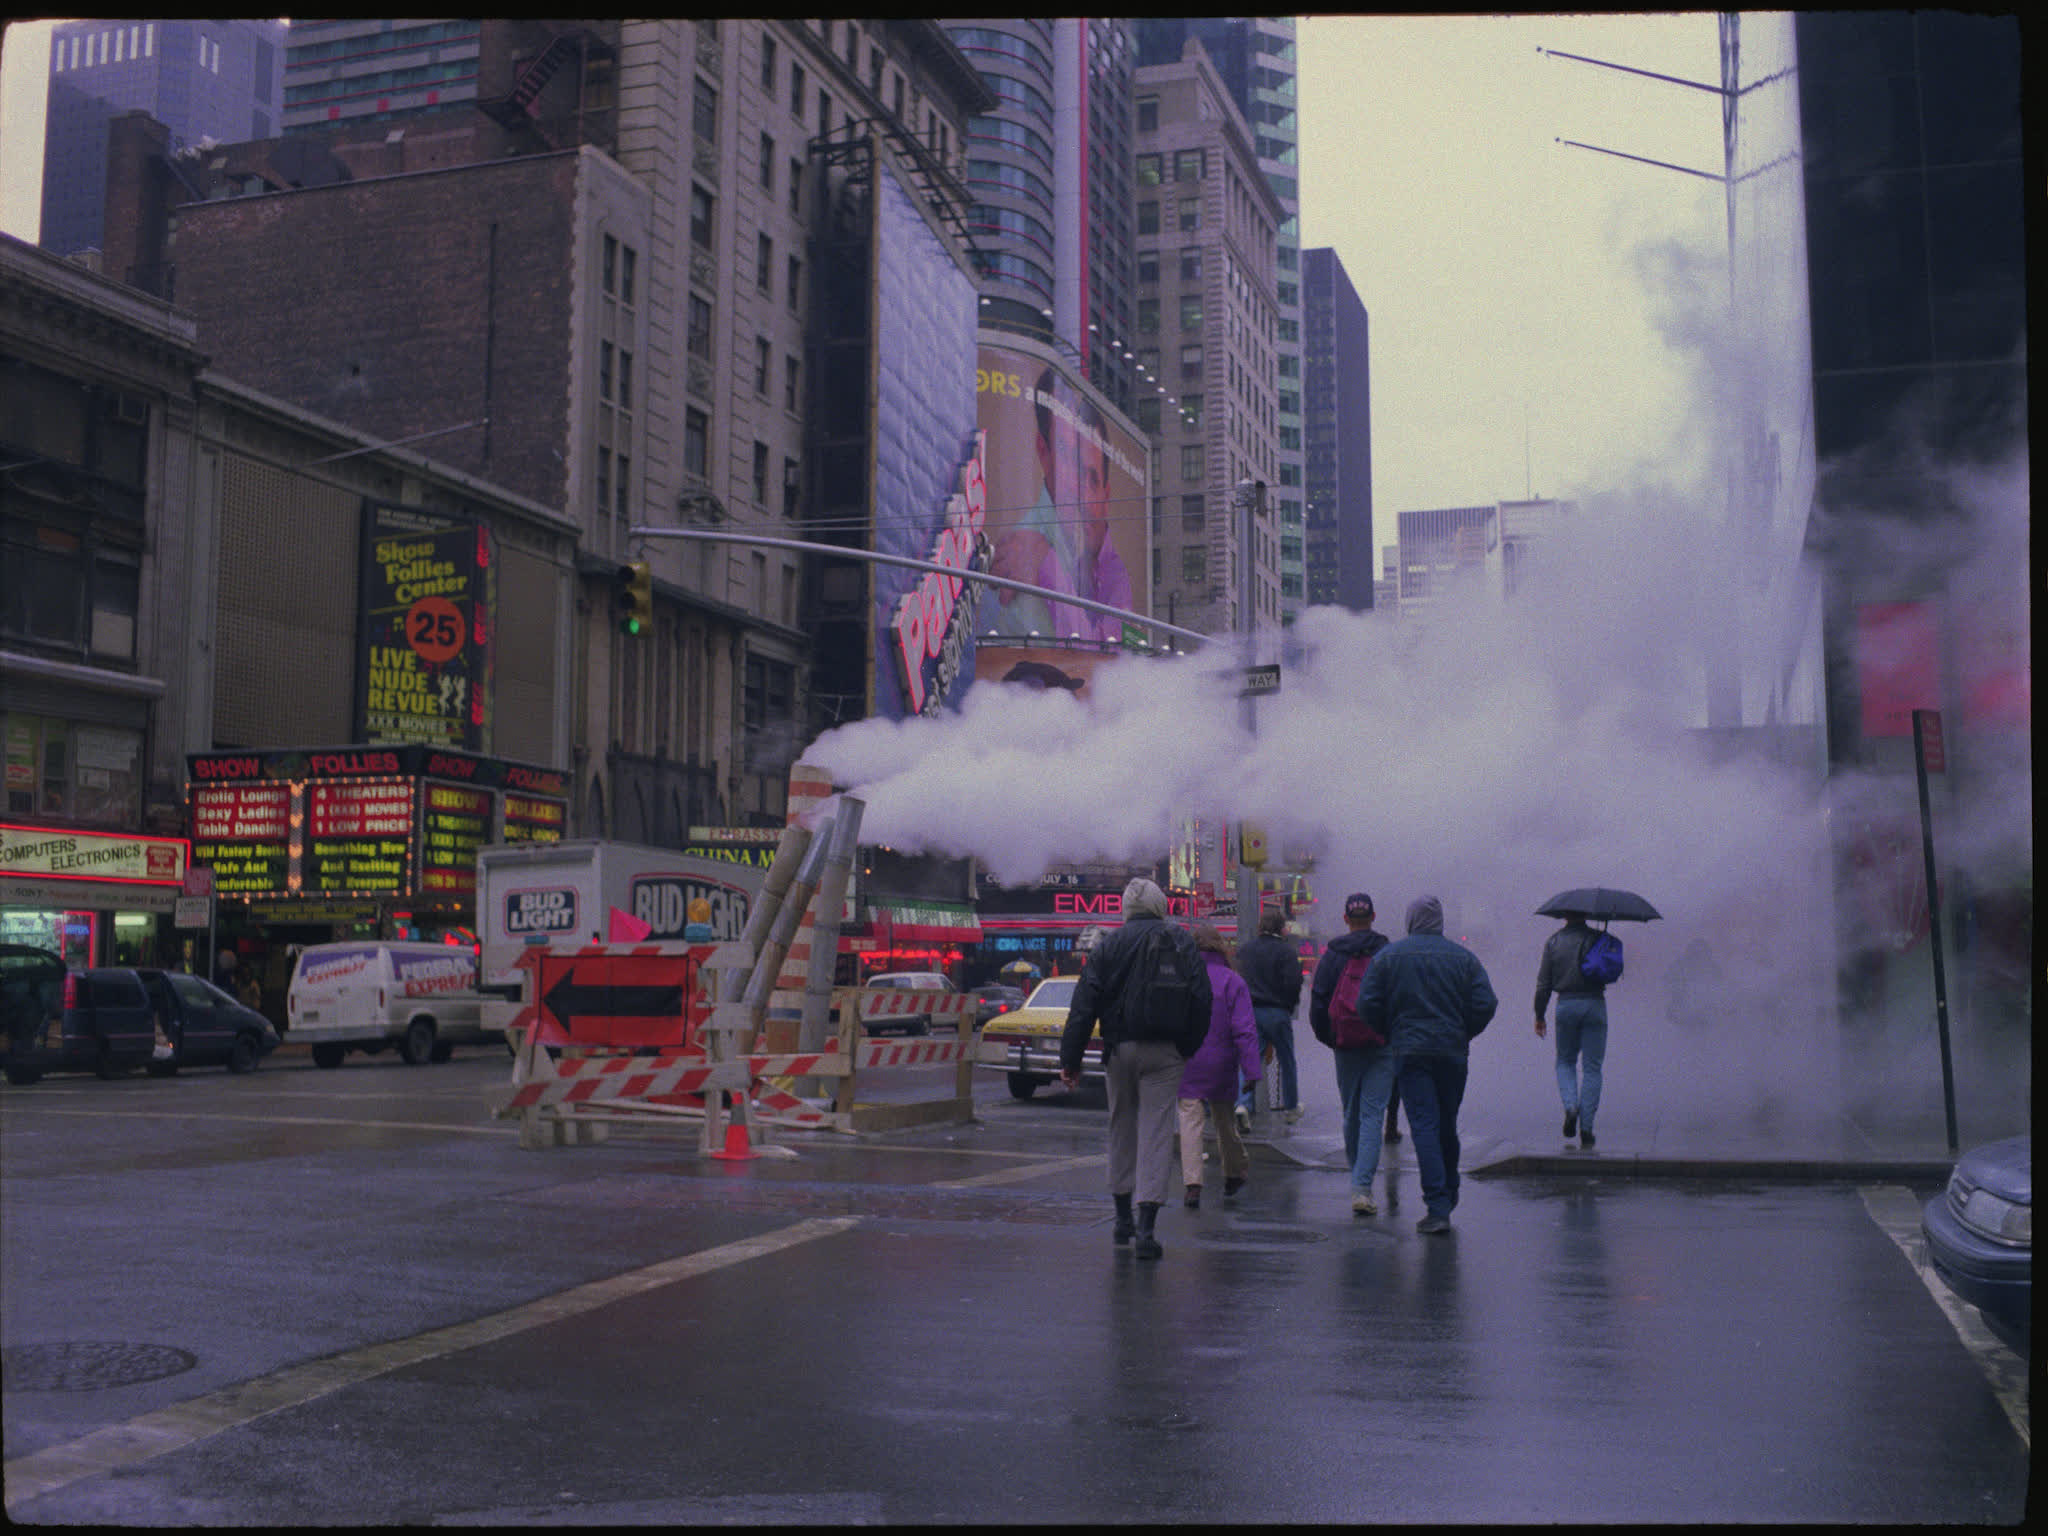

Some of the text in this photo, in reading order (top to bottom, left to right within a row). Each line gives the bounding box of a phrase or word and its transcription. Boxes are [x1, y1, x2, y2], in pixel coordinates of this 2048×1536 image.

[376, 541, 435, 565] Show
[386, 560, 455, 584] Follies
[395, 576, 468, 604] Center
[414, 612, 456, 646] 25
[371, 645, 416, 671] LIVE
[369, 668, 428, 693] NUDE
[1248, 672, 1273, 687] WAY
[368, 689, 439, 716] REVUE
[367, 714, 395, 730] XXX
[195, 752, 400, 779] SHOW FOLLIES
[428, 755, 478, 778] SHOW
[316, 786, 408, 801] 4 THEATERS
[431, 788, 479, 809] SHOW
[364, 803, 408, 817] MOVIES
[197, 823, 230, 837] Table
[329, 820, 361, 833] LOW
[365, 819, 408, 833] PRICE
[51, 844, 141, 870] ELECTRONICS
[519, 891, 566, 912] BUD
[636, 883, 684, 934] BUD
[510, 908, 575, 931] LIGHT
